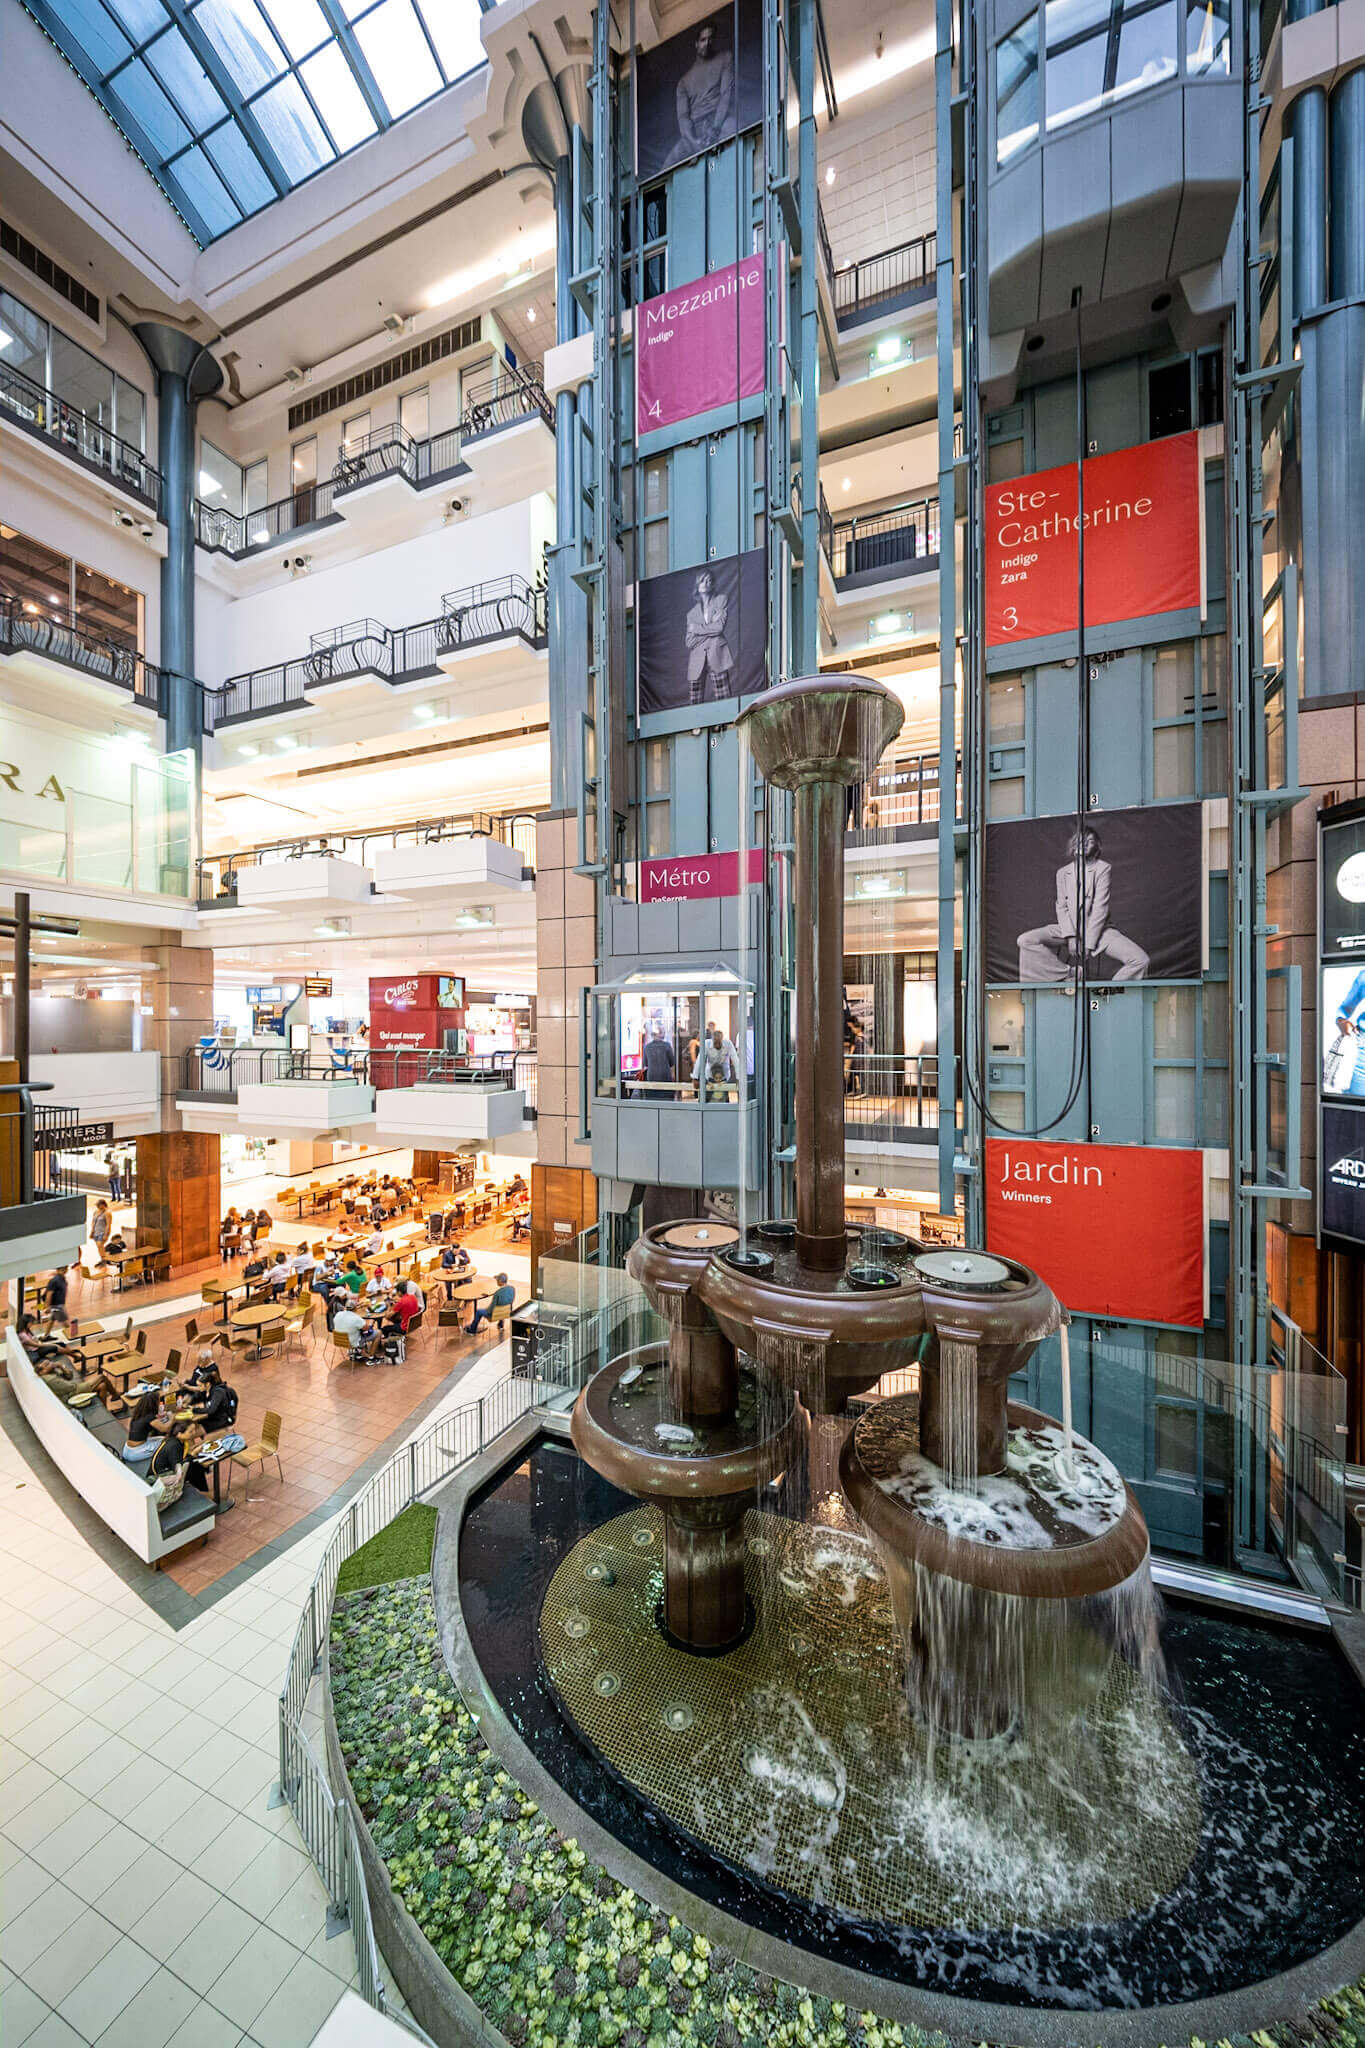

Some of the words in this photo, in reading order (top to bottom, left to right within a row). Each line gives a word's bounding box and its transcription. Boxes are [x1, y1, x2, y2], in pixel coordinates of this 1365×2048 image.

[647, 270, 760, 329] Mezzanine
[648, 330, 674, 345] Indigo
[649, 400, 663, 418] 4
[998, 490, 1061, 517] Ste-
[998, 497, 1153, 547] Catherine
[1001, 553, 1039, 569] Indigo
[1001, 571, 1028, 585] Zara
[1002, 606, 1019, 631] 3
[650, 867, 711, 889] Métro
[384, 980, 418, 1004] CARLO'S
[1001, 1152, 1102, 1187] Jardin
[1001, 1190, 1052, 1204] Winners
